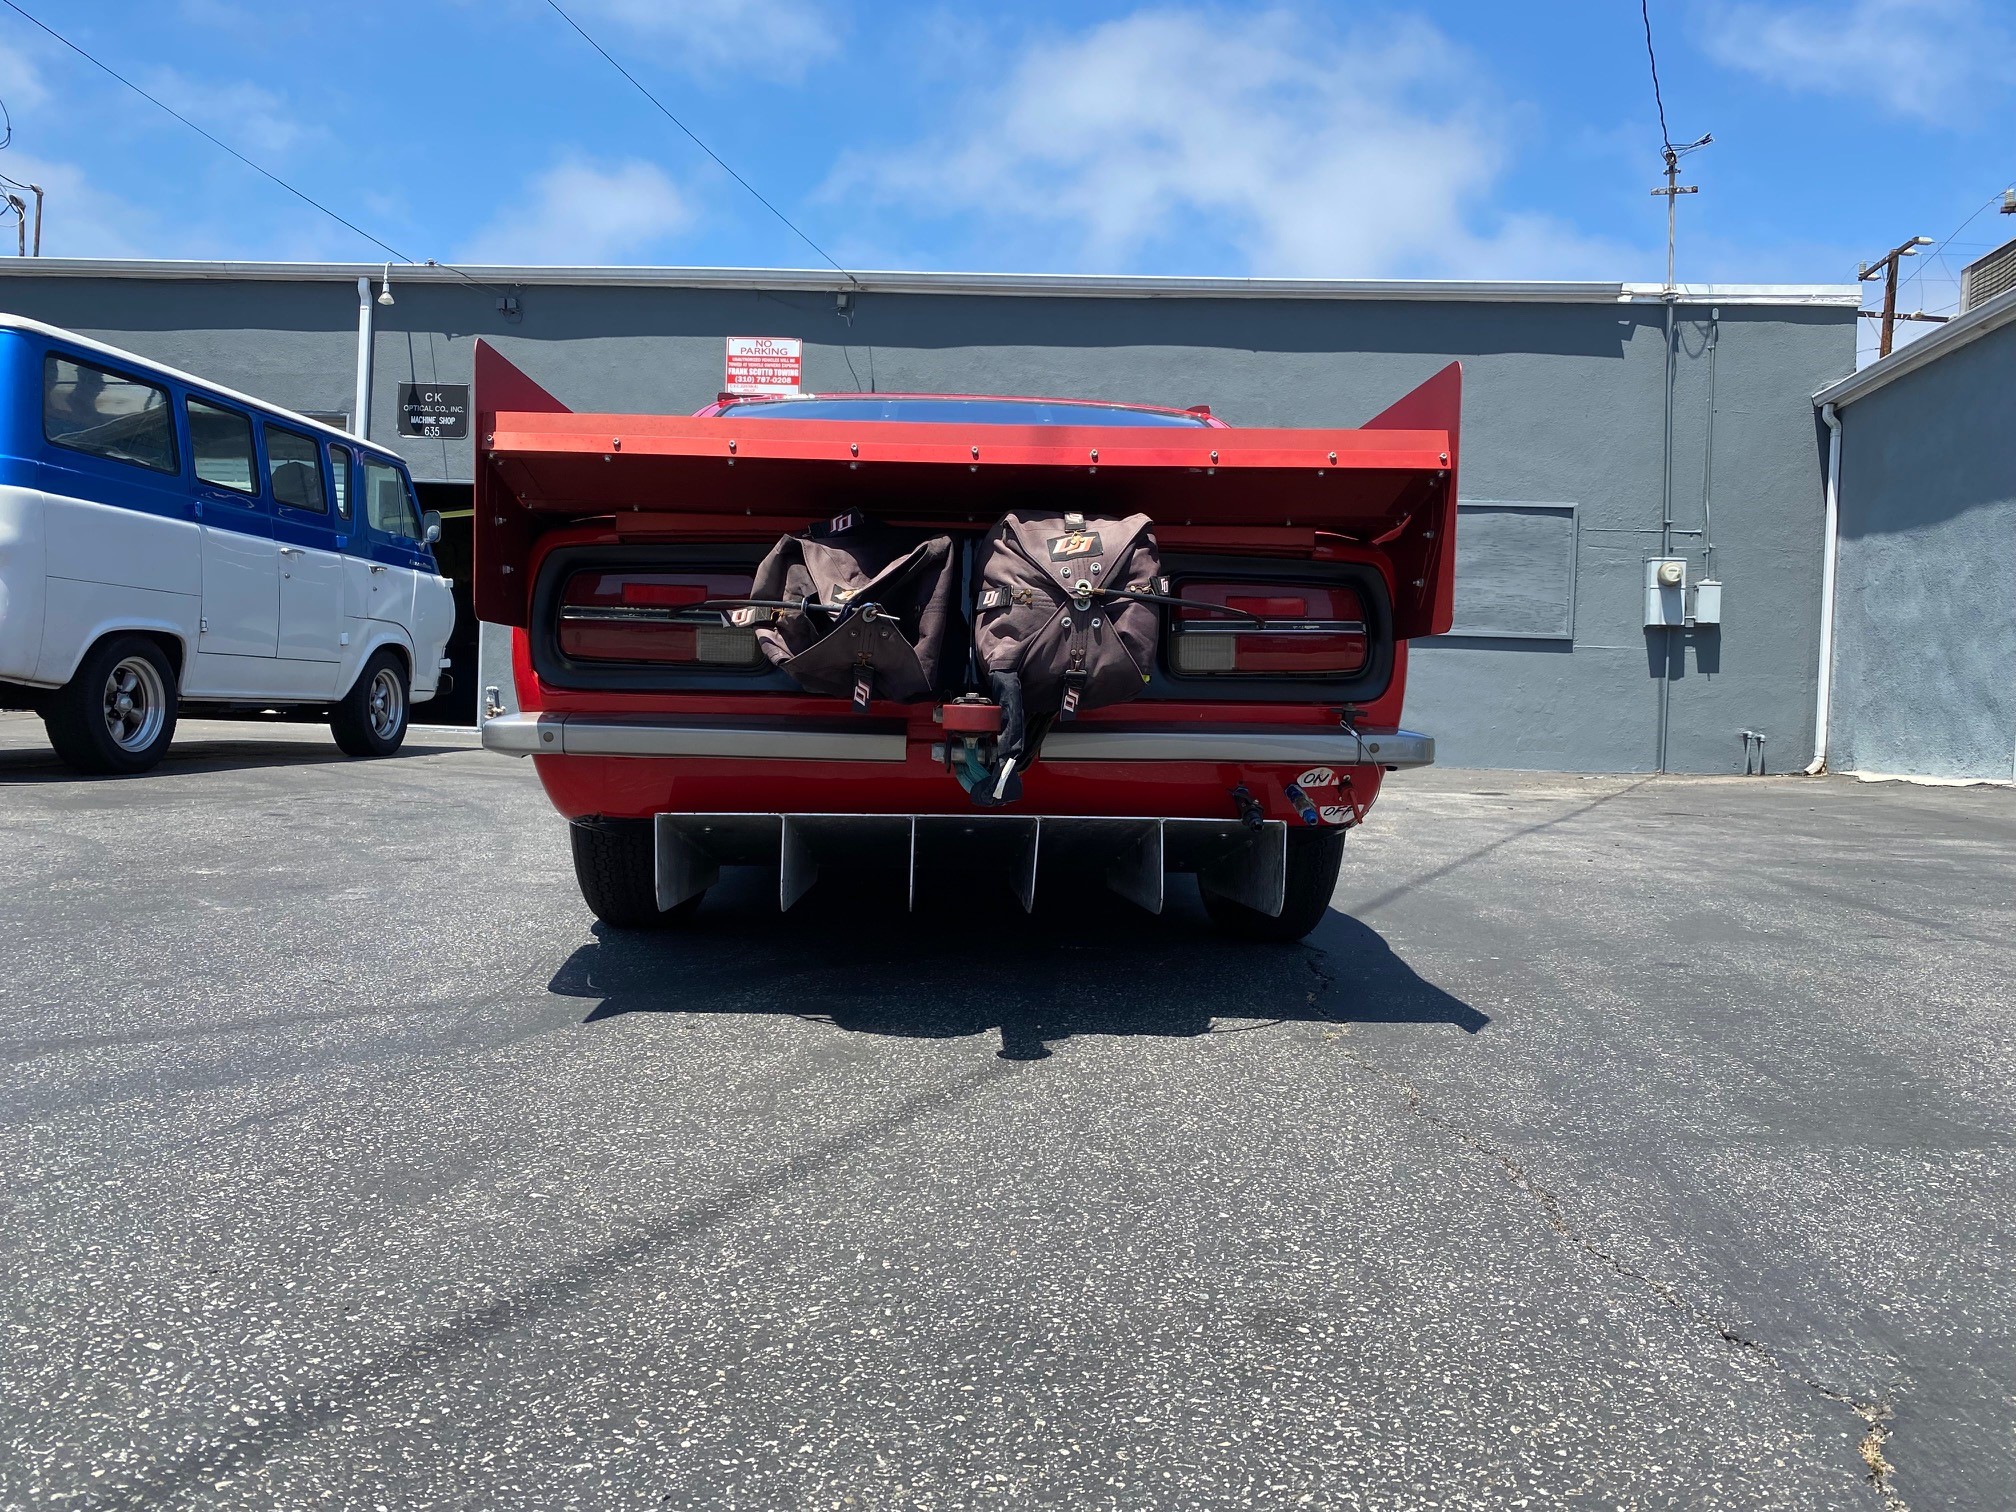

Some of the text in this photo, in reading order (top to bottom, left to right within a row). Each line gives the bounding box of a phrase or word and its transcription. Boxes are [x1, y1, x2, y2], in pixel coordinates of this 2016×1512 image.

[740, 347, 788, 356] PARKING
[728, 368, 799, 377] FRANK SCOTTO TOWING
[735, 376, 755, 384] (310)
[435, 405, 449, 413] CO.,
[411, 416, 456, 425] MACHINE SHOP
[424, 426, 440, 437] 635
[1303, 773, 1330, 784] ON
[1323, 806, 1354, 816] OFF
